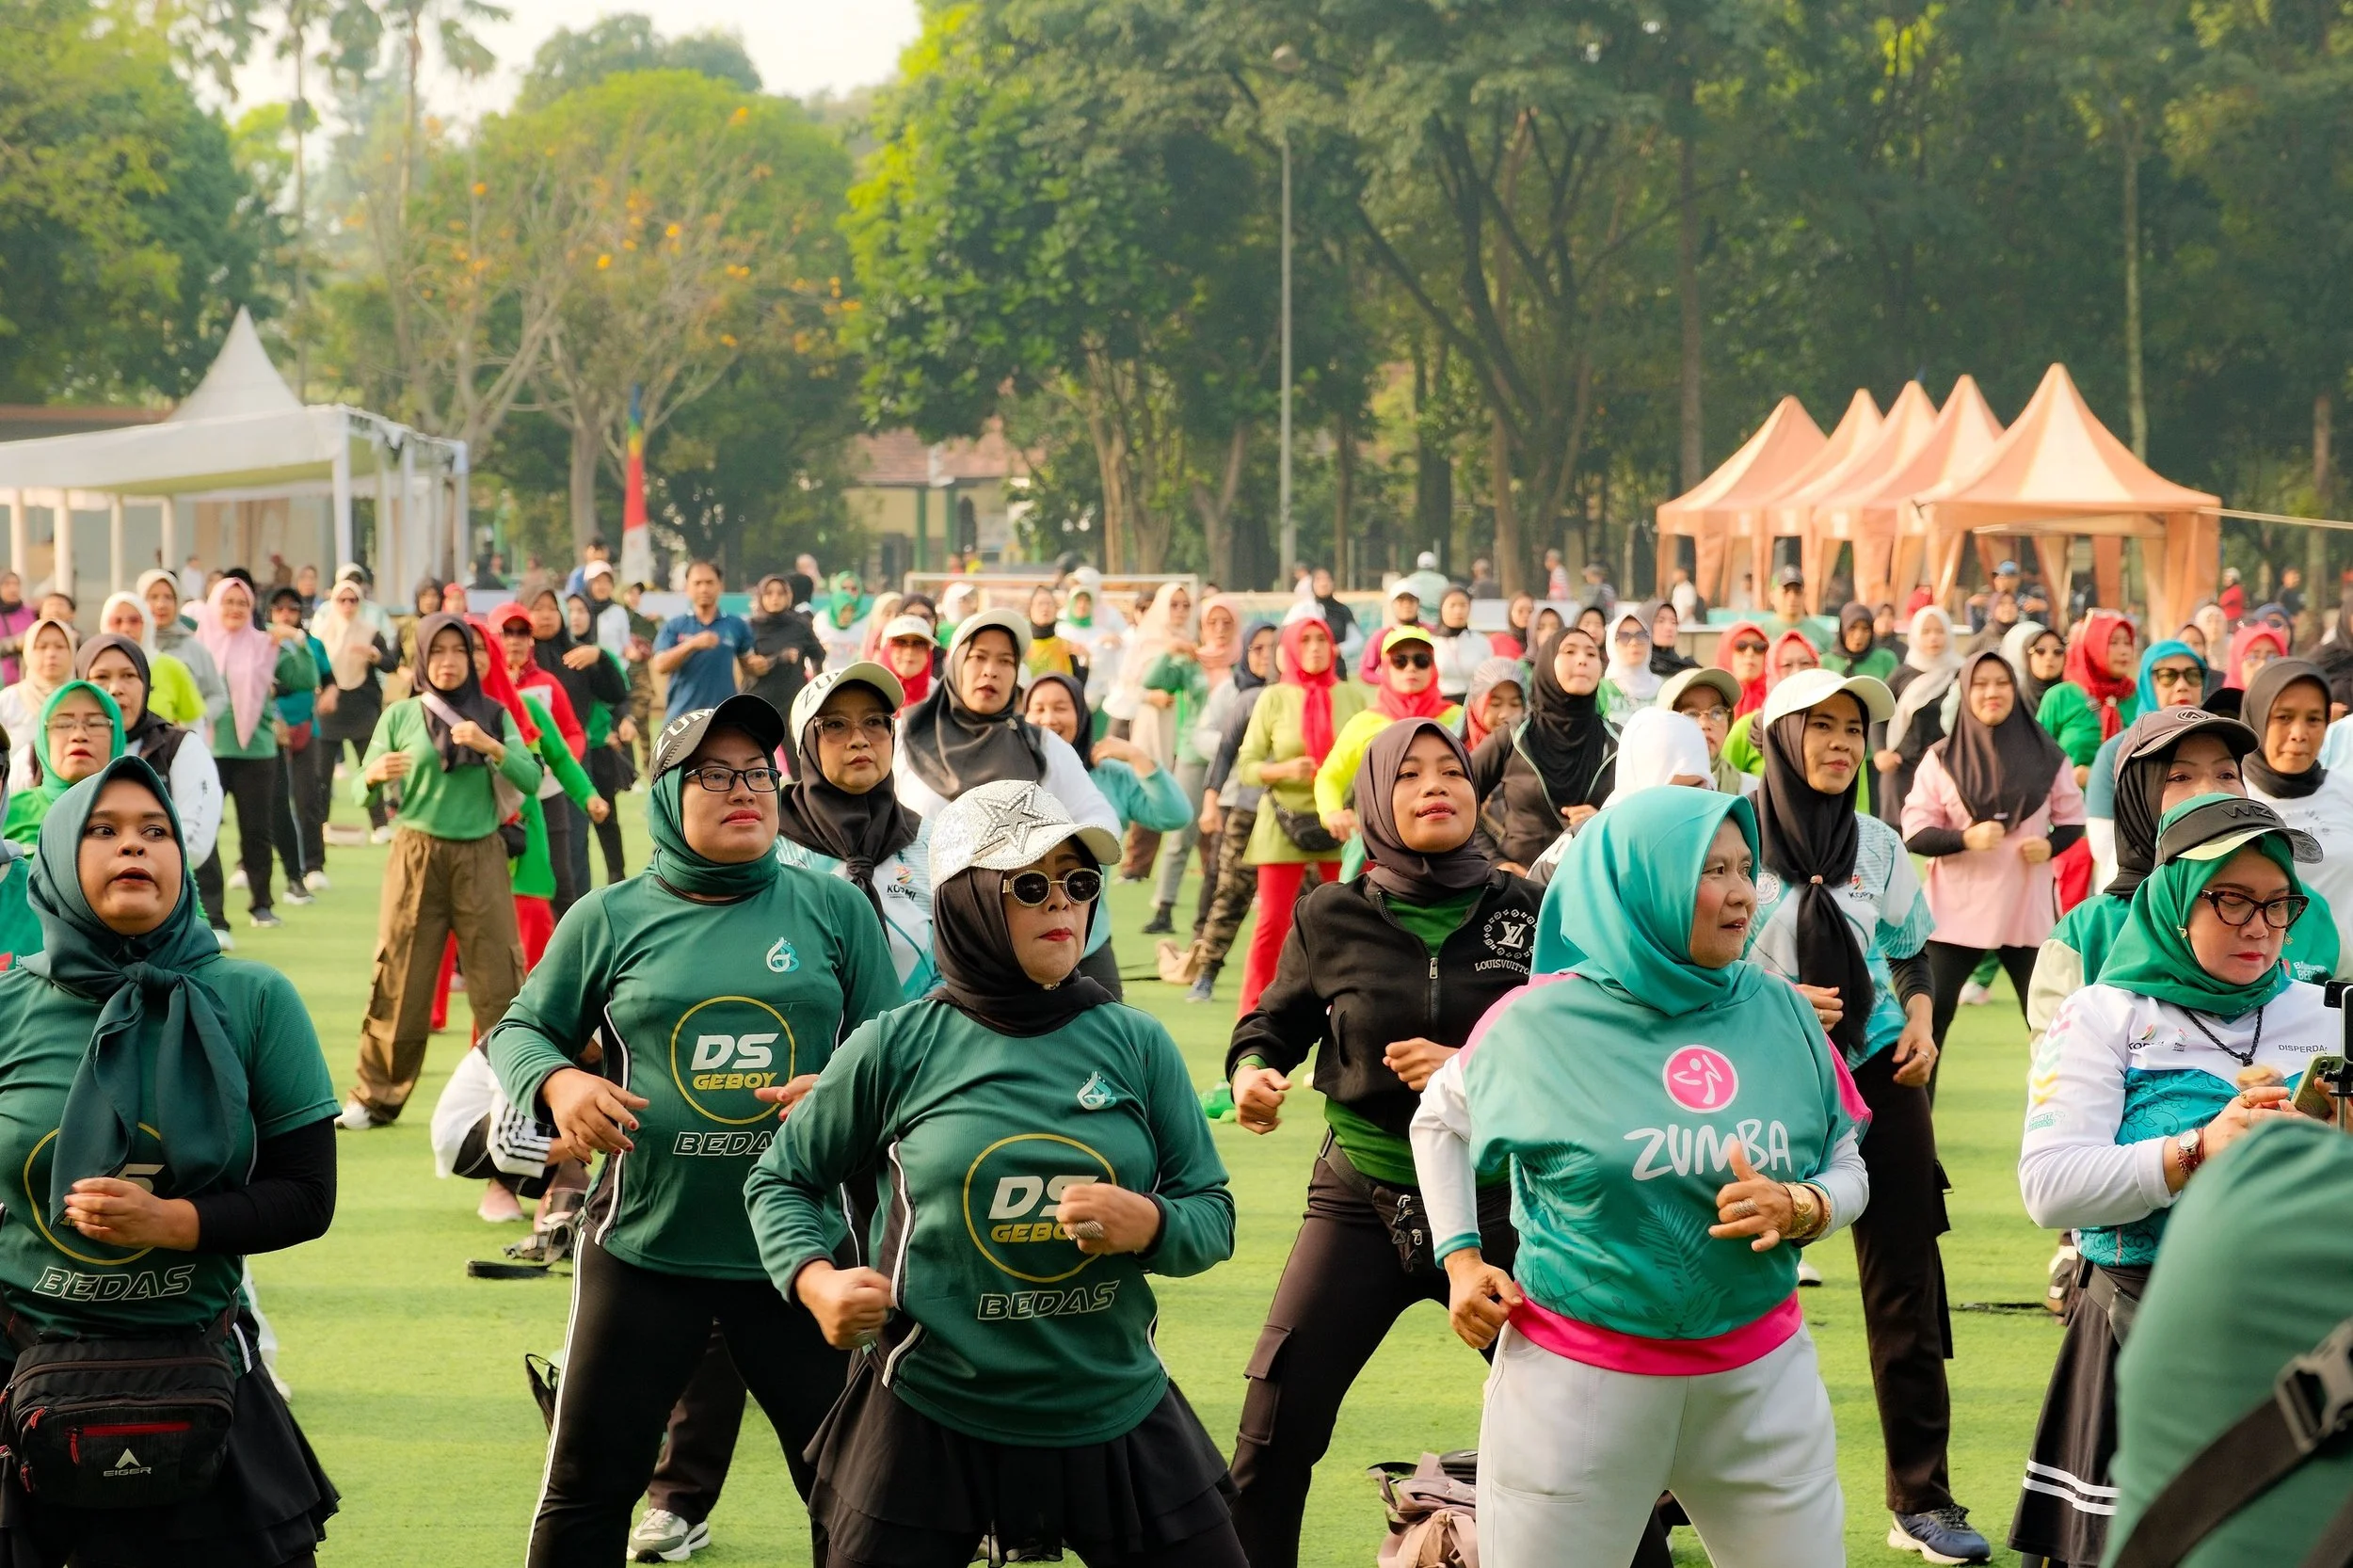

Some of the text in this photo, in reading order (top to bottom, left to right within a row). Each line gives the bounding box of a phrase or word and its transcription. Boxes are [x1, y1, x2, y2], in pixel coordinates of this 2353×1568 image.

[1475, 959, 1530, 976] LOUISVUITTO
[691, 1033, 779, 1071] DS
[693, 1072, 777, 1091] GEBOY
[673, 1131, 773, 1157] BEDA
[1624, 1119, 1792, 1181] ZUMBA
[988, 1176, 1099, 1220] DS
[991, 1224, 1071, 1243] GEBO
[32, 1264, 196, 1303] BEDAS
[978, 1280, 1120, 1320] BEDAS
[103, 1466, 152, 1478] EIGER
